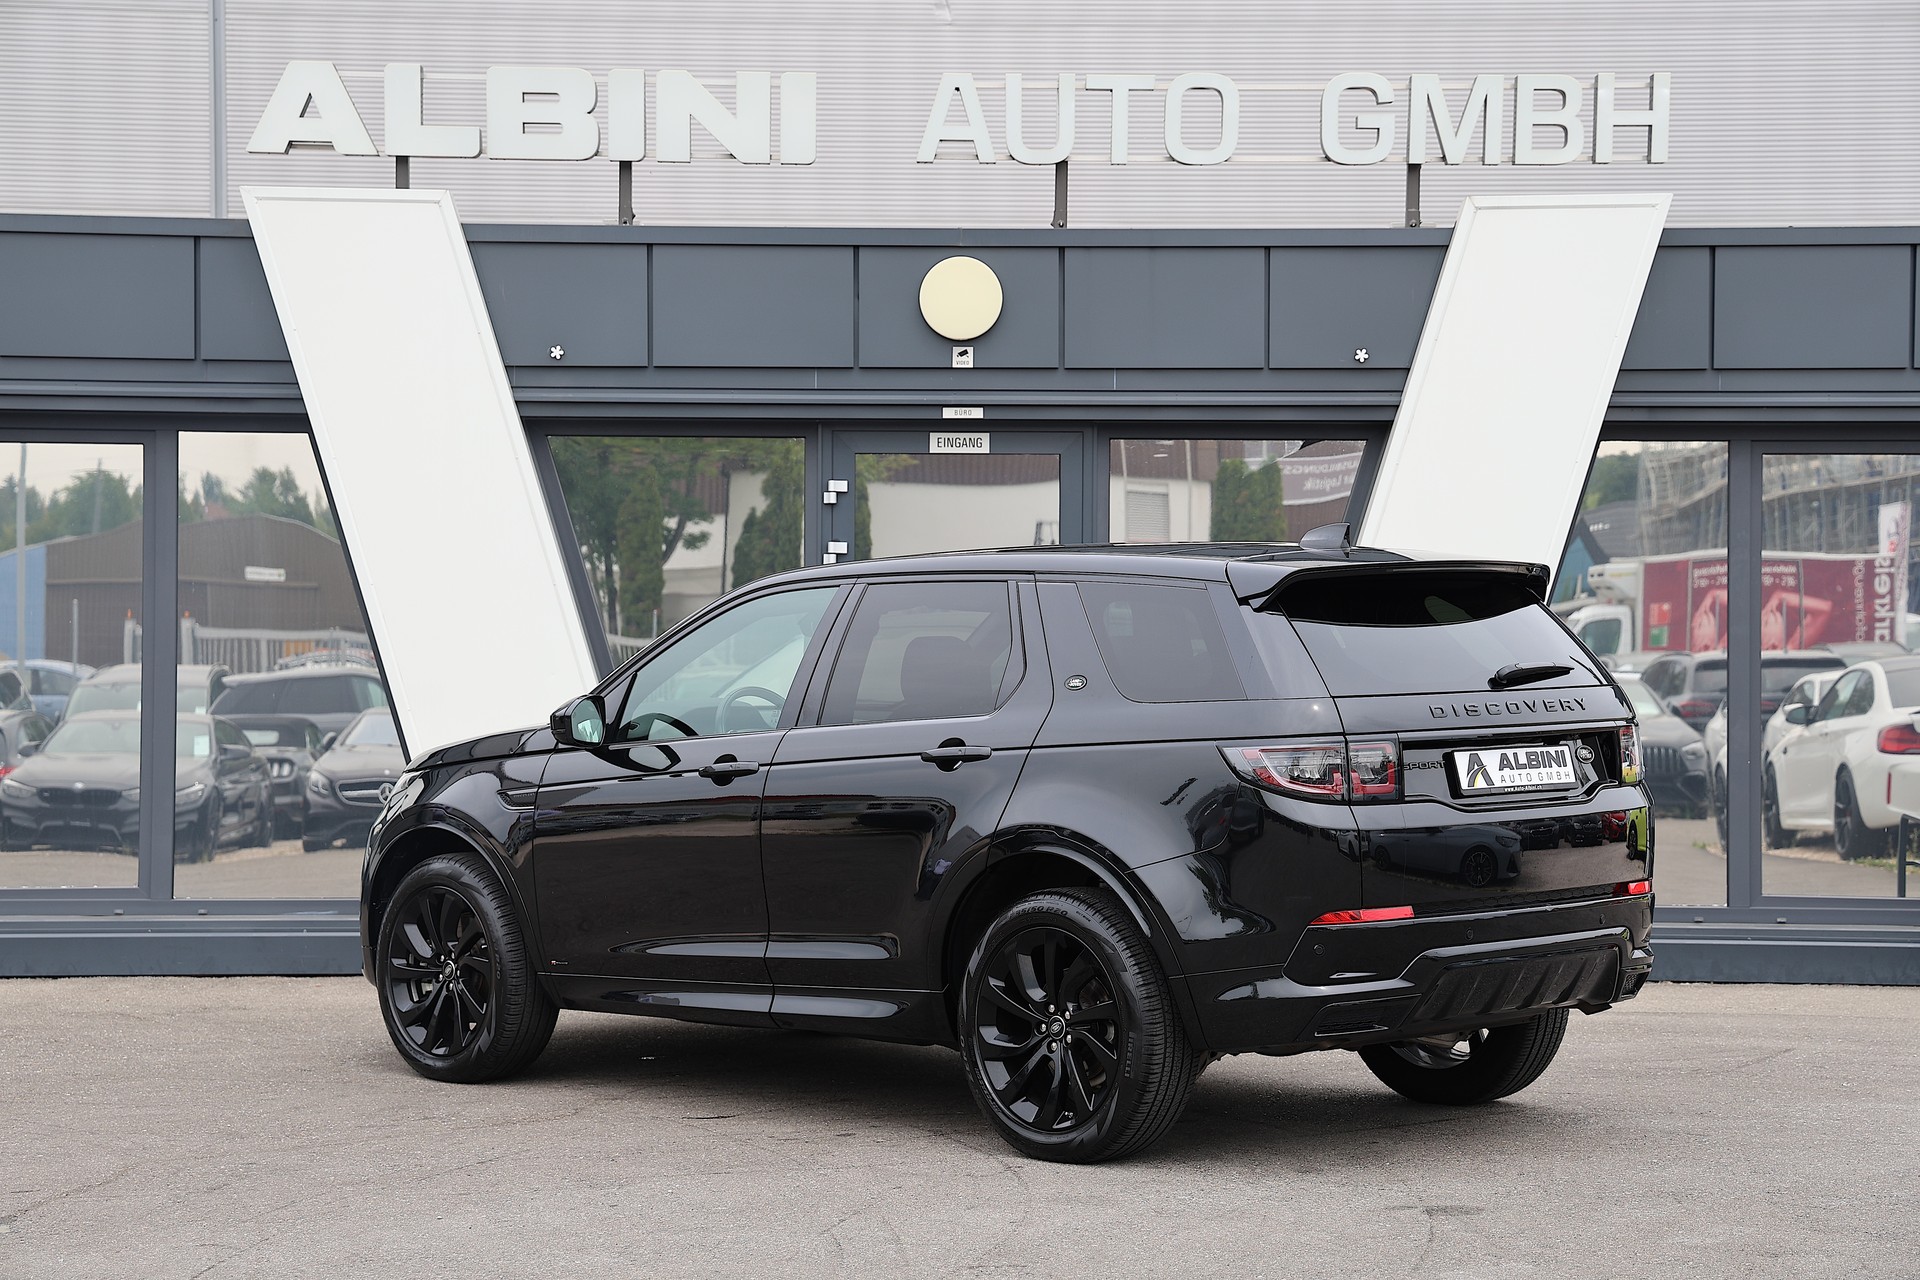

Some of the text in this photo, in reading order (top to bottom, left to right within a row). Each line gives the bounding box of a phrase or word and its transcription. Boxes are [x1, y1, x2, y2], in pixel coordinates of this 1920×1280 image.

[246, 60, 1671, 167] ALBINI AUTO GMBH
[954, 408, 973, 416] BÜRO
[936, 437, 983, 449] EINGANG
[1429, 698, 1586, 718] DISCOVERY
[1498, 750, 1568, 771] ALBINI
[1500, 770, 1572, 784] AUTO GMBH
